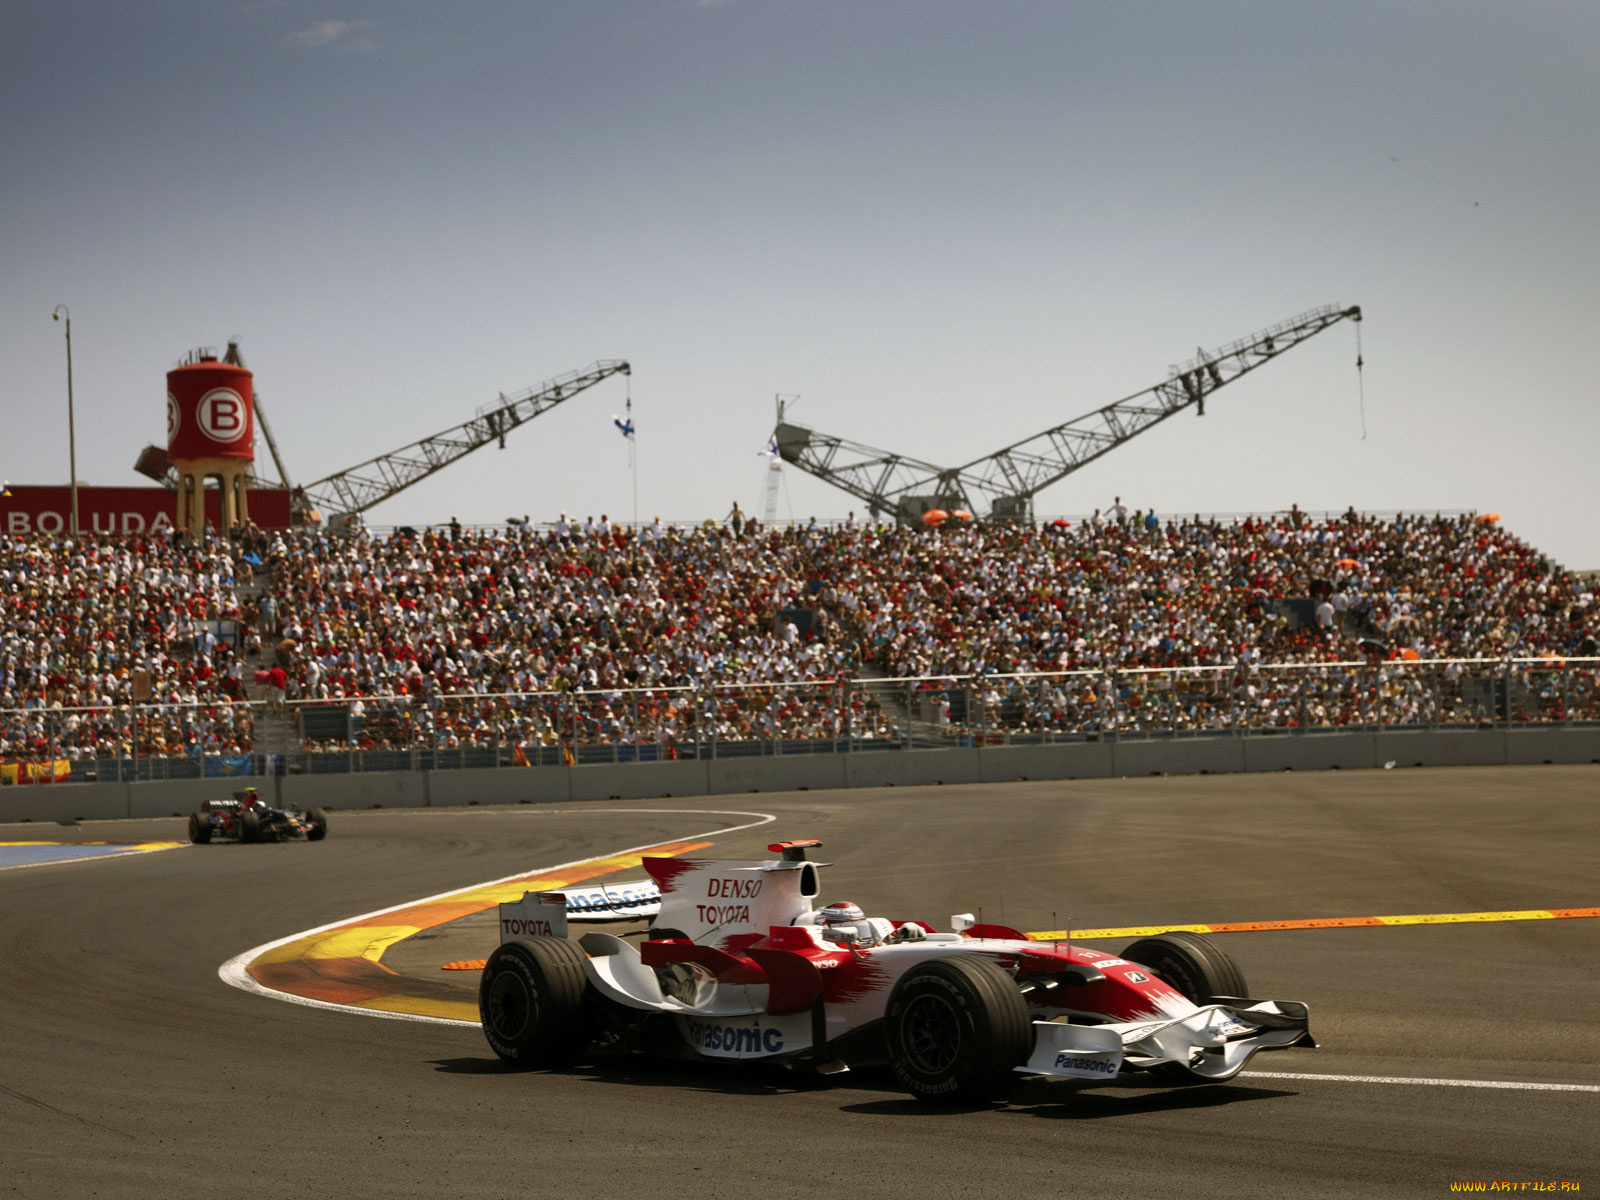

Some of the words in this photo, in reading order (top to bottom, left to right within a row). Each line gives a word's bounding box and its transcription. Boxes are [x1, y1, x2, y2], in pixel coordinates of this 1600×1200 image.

[210, 400, 240, 430] B
[707, 878, 763, 899] DENSO
[696, 904, 750, 924] TOYOTA
[502, 919, 553, 936] TOYOTA
[812, 959, 839, 969] NSO
[1054, 1054, 1116, 1074] Panasonic
